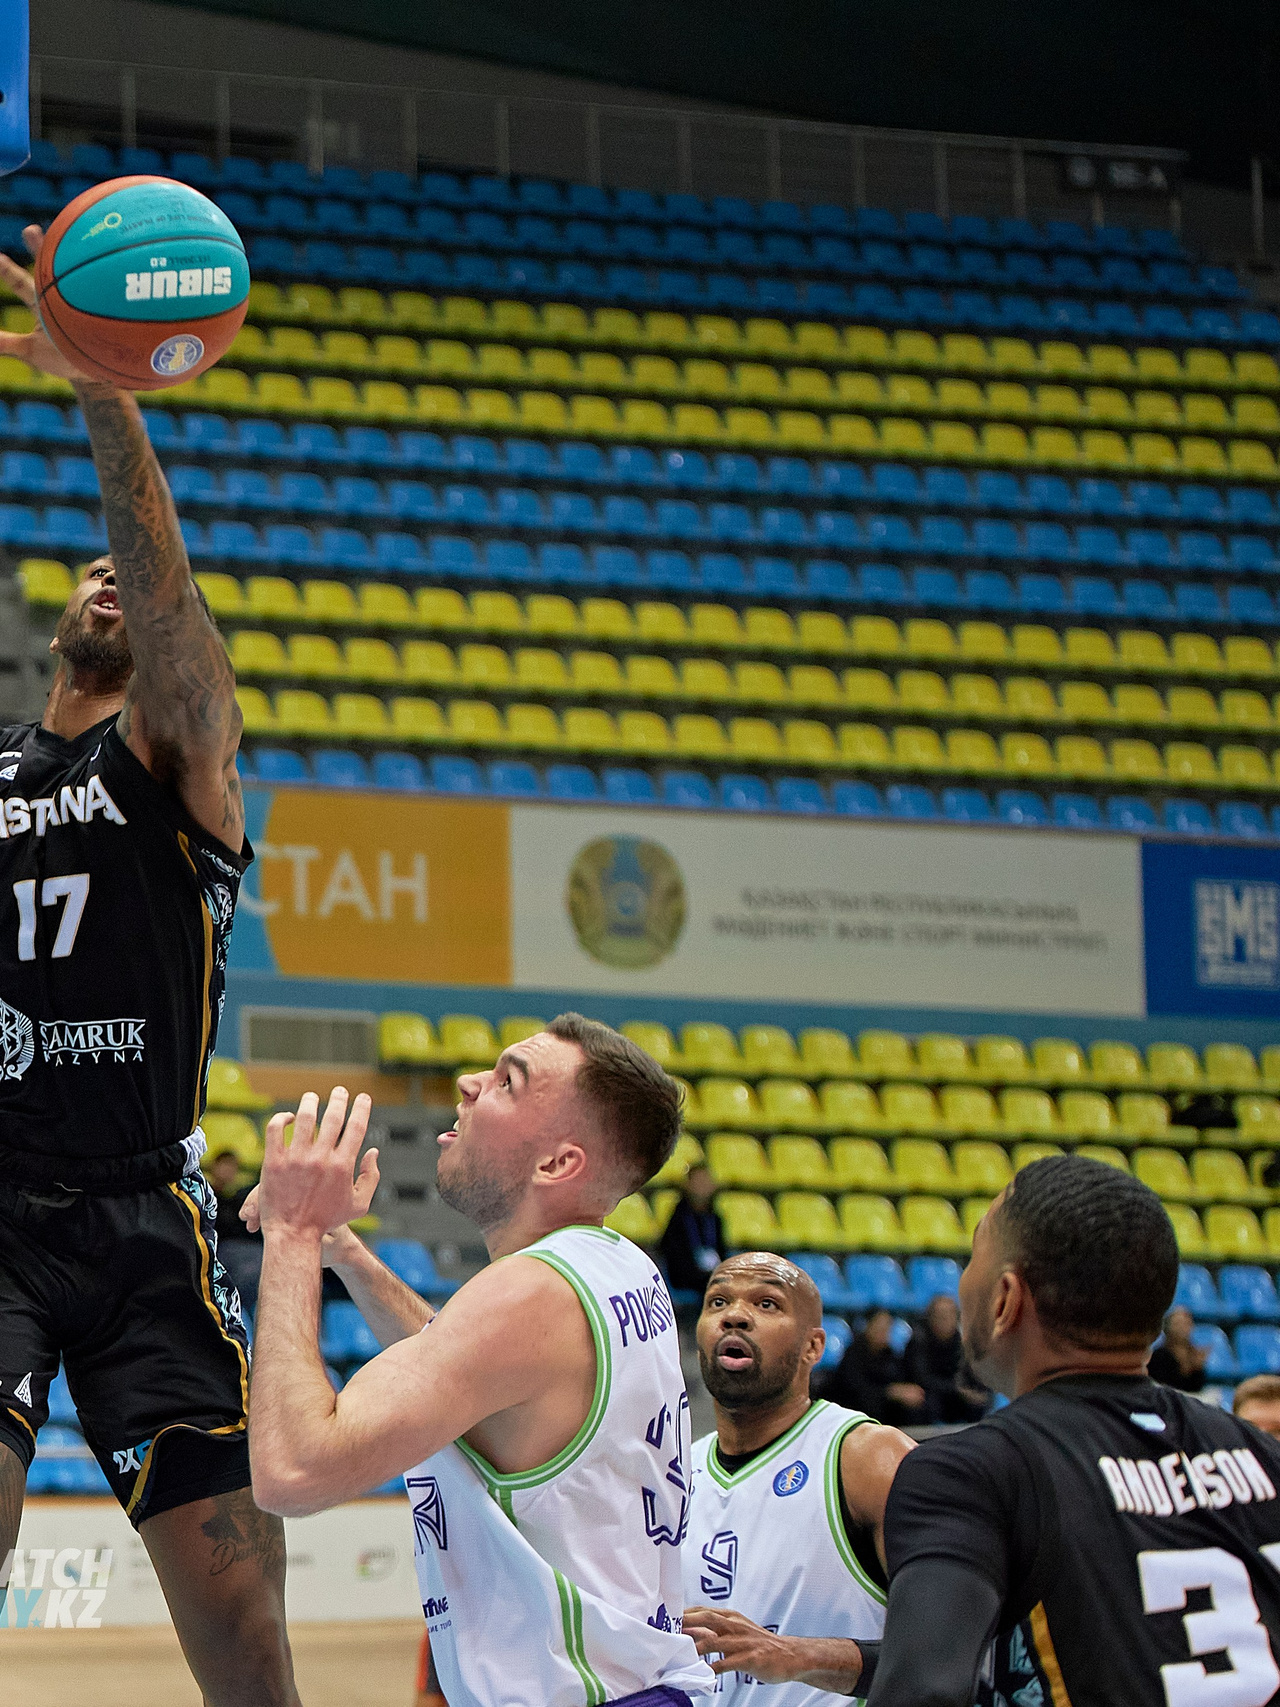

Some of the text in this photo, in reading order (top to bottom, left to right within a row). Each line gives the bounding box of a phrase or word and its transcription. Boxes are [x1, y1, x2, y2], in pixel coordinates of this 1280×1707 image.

[125, 266, 232, 301] SIBUR
[12, 872, 90, 962] 17
[40, 1022, 146, 1050] SAMRUK
[43, 1049, 143, 1067] KAZYNA
[1136, 1547, 1280, 1707] 3
